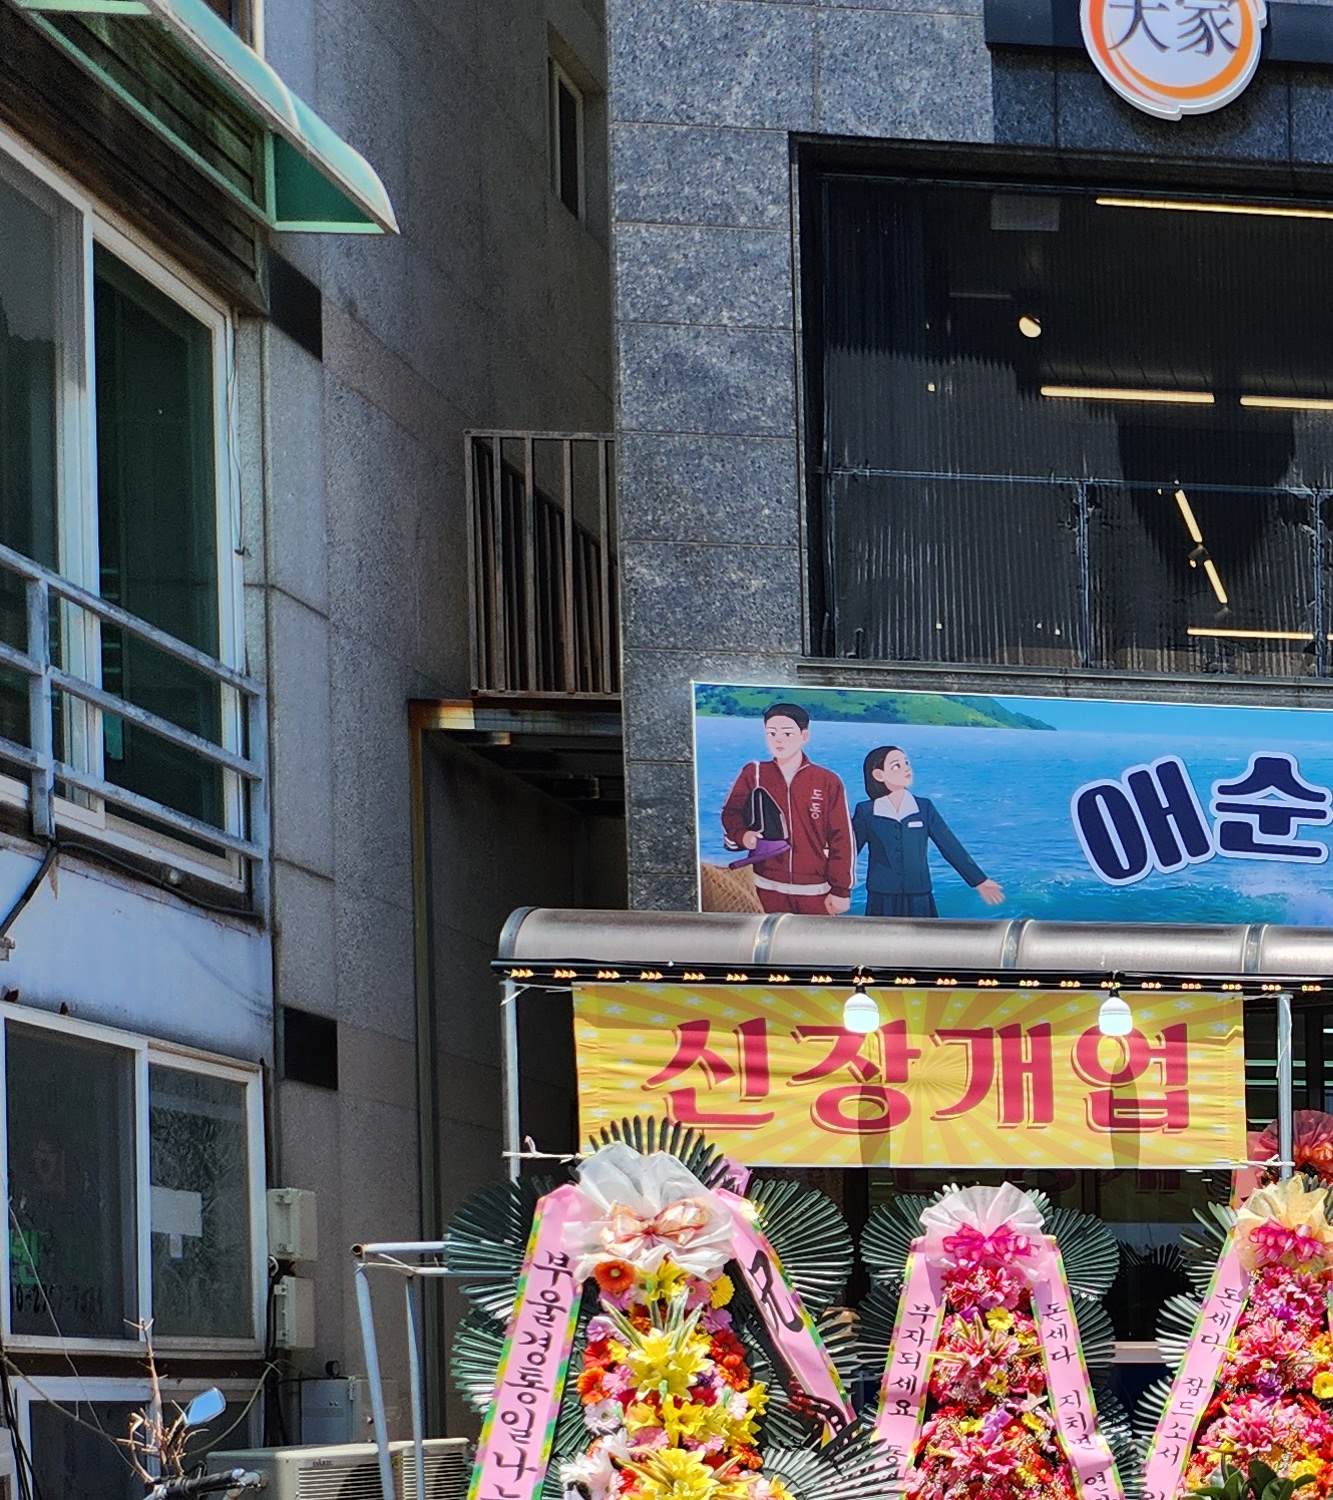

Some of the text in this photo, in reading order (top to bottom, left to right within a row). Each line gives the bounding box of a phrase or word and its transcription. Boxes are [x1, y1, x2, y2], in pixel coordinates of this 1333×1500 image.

[641, 1017, 1189, 1133] 신장개업
[887, 1303, 937, 1418] 부자되세요
[1042, 1303, 1078, 1367] 돈세다
[1200, 1287, 1241, 1353] 돈세다
